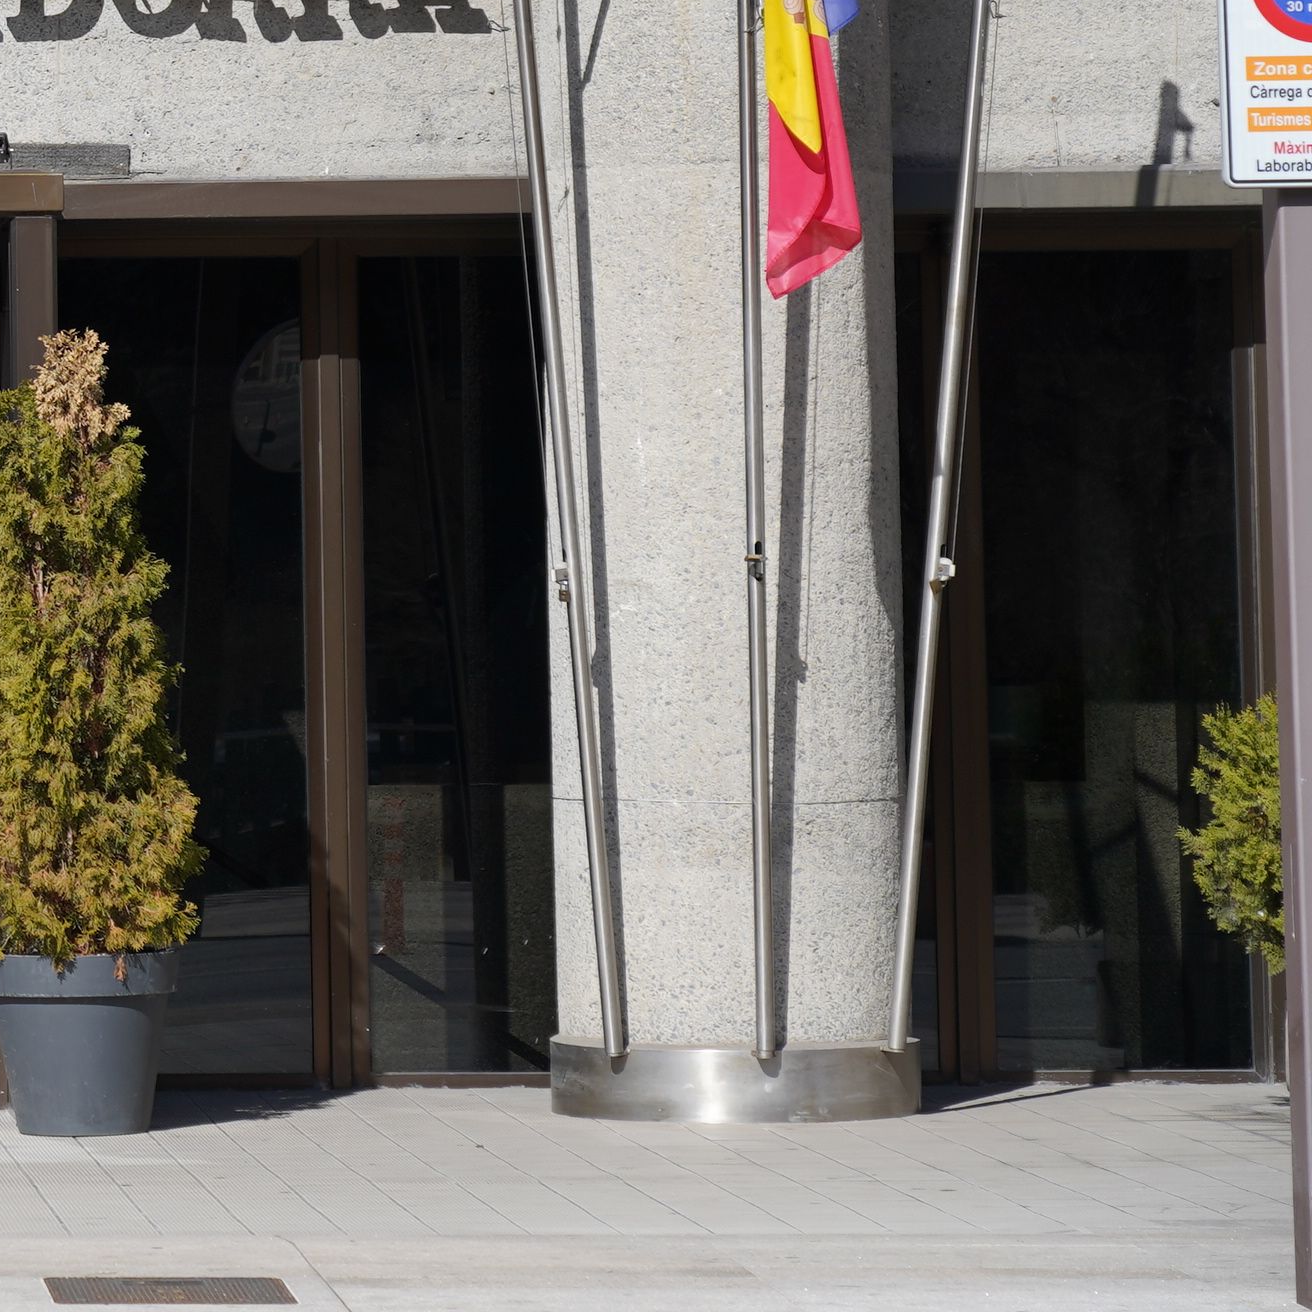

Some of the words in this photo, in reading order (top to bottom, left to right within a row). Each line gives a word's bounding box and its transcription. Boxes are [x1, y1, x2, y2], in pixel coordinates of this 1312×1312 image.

[1287, 0, 1303, 12] 30
[1254, 61, 1297, 76] Zona
[1250, 84, 1302, 101] Càrrega
[1251, 112, 1312, 127] Turismes
[1257, 158, 1312, 172] Laborab
